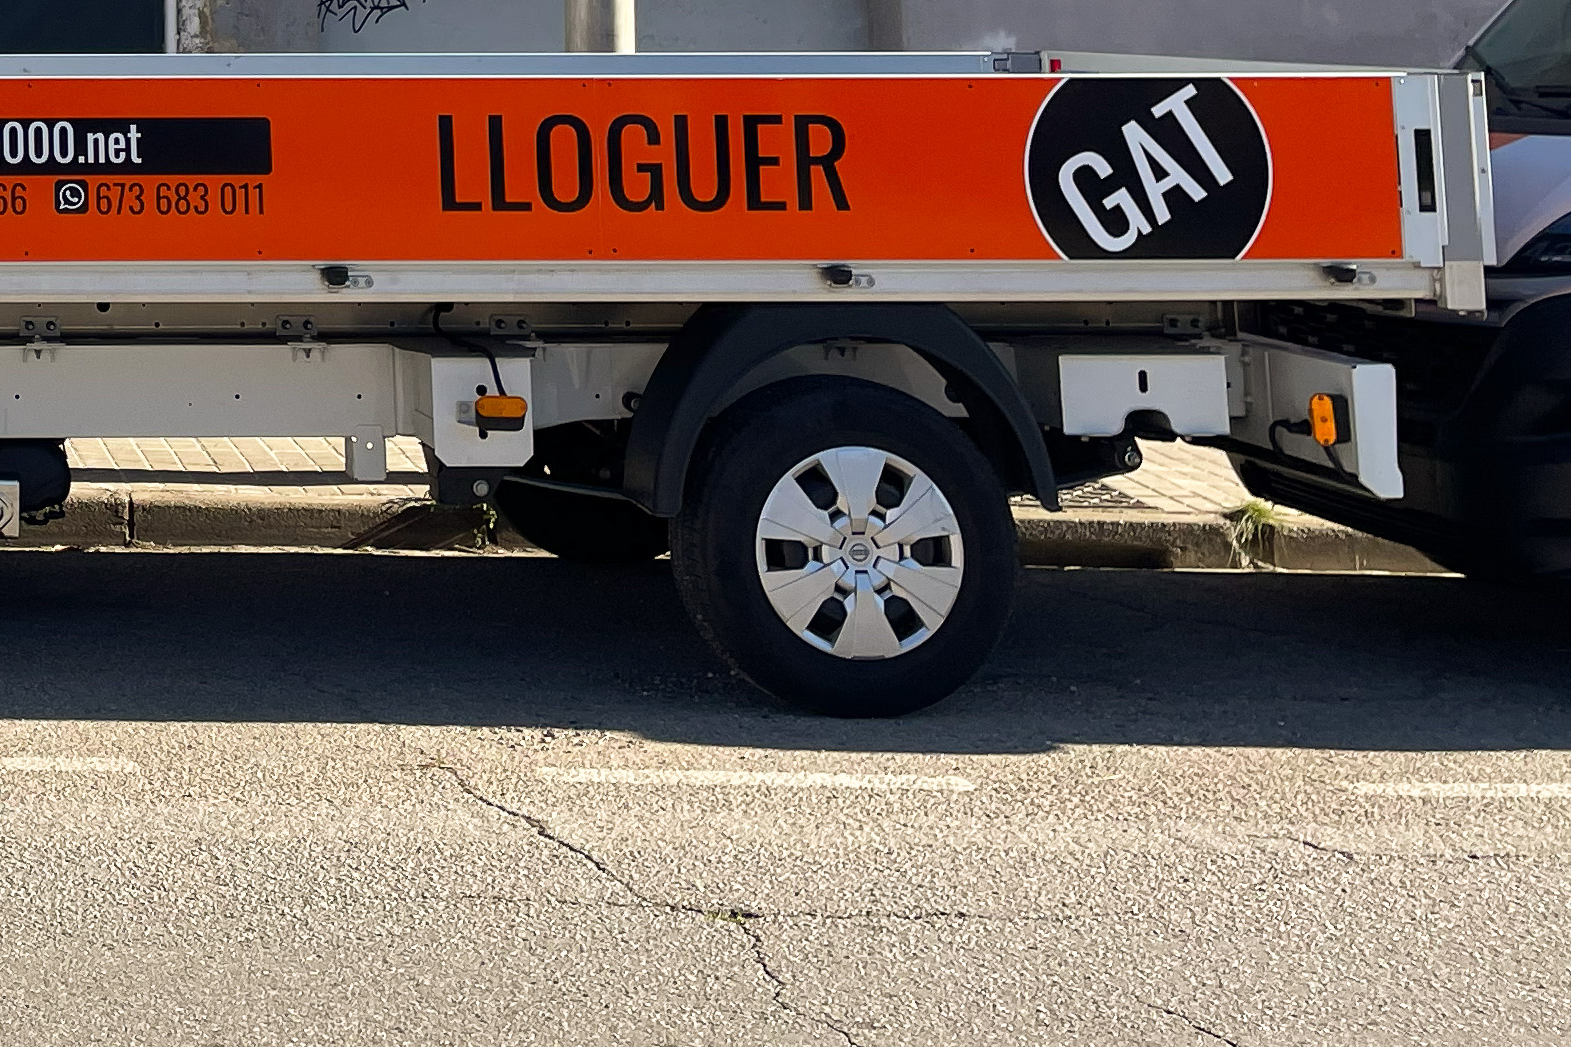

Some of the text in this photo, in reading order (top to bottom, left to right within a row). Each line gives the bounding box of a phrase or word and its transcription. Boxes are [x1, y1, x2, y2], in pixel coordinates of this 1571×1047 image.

[96, 182, 145, 215] 673
[155, 182, 210, 215] 683
[220, 182, 266, 215] 011
[437, 113, 851, 212] LLOGUER
[1057, 83, 1233, 253] GAT
